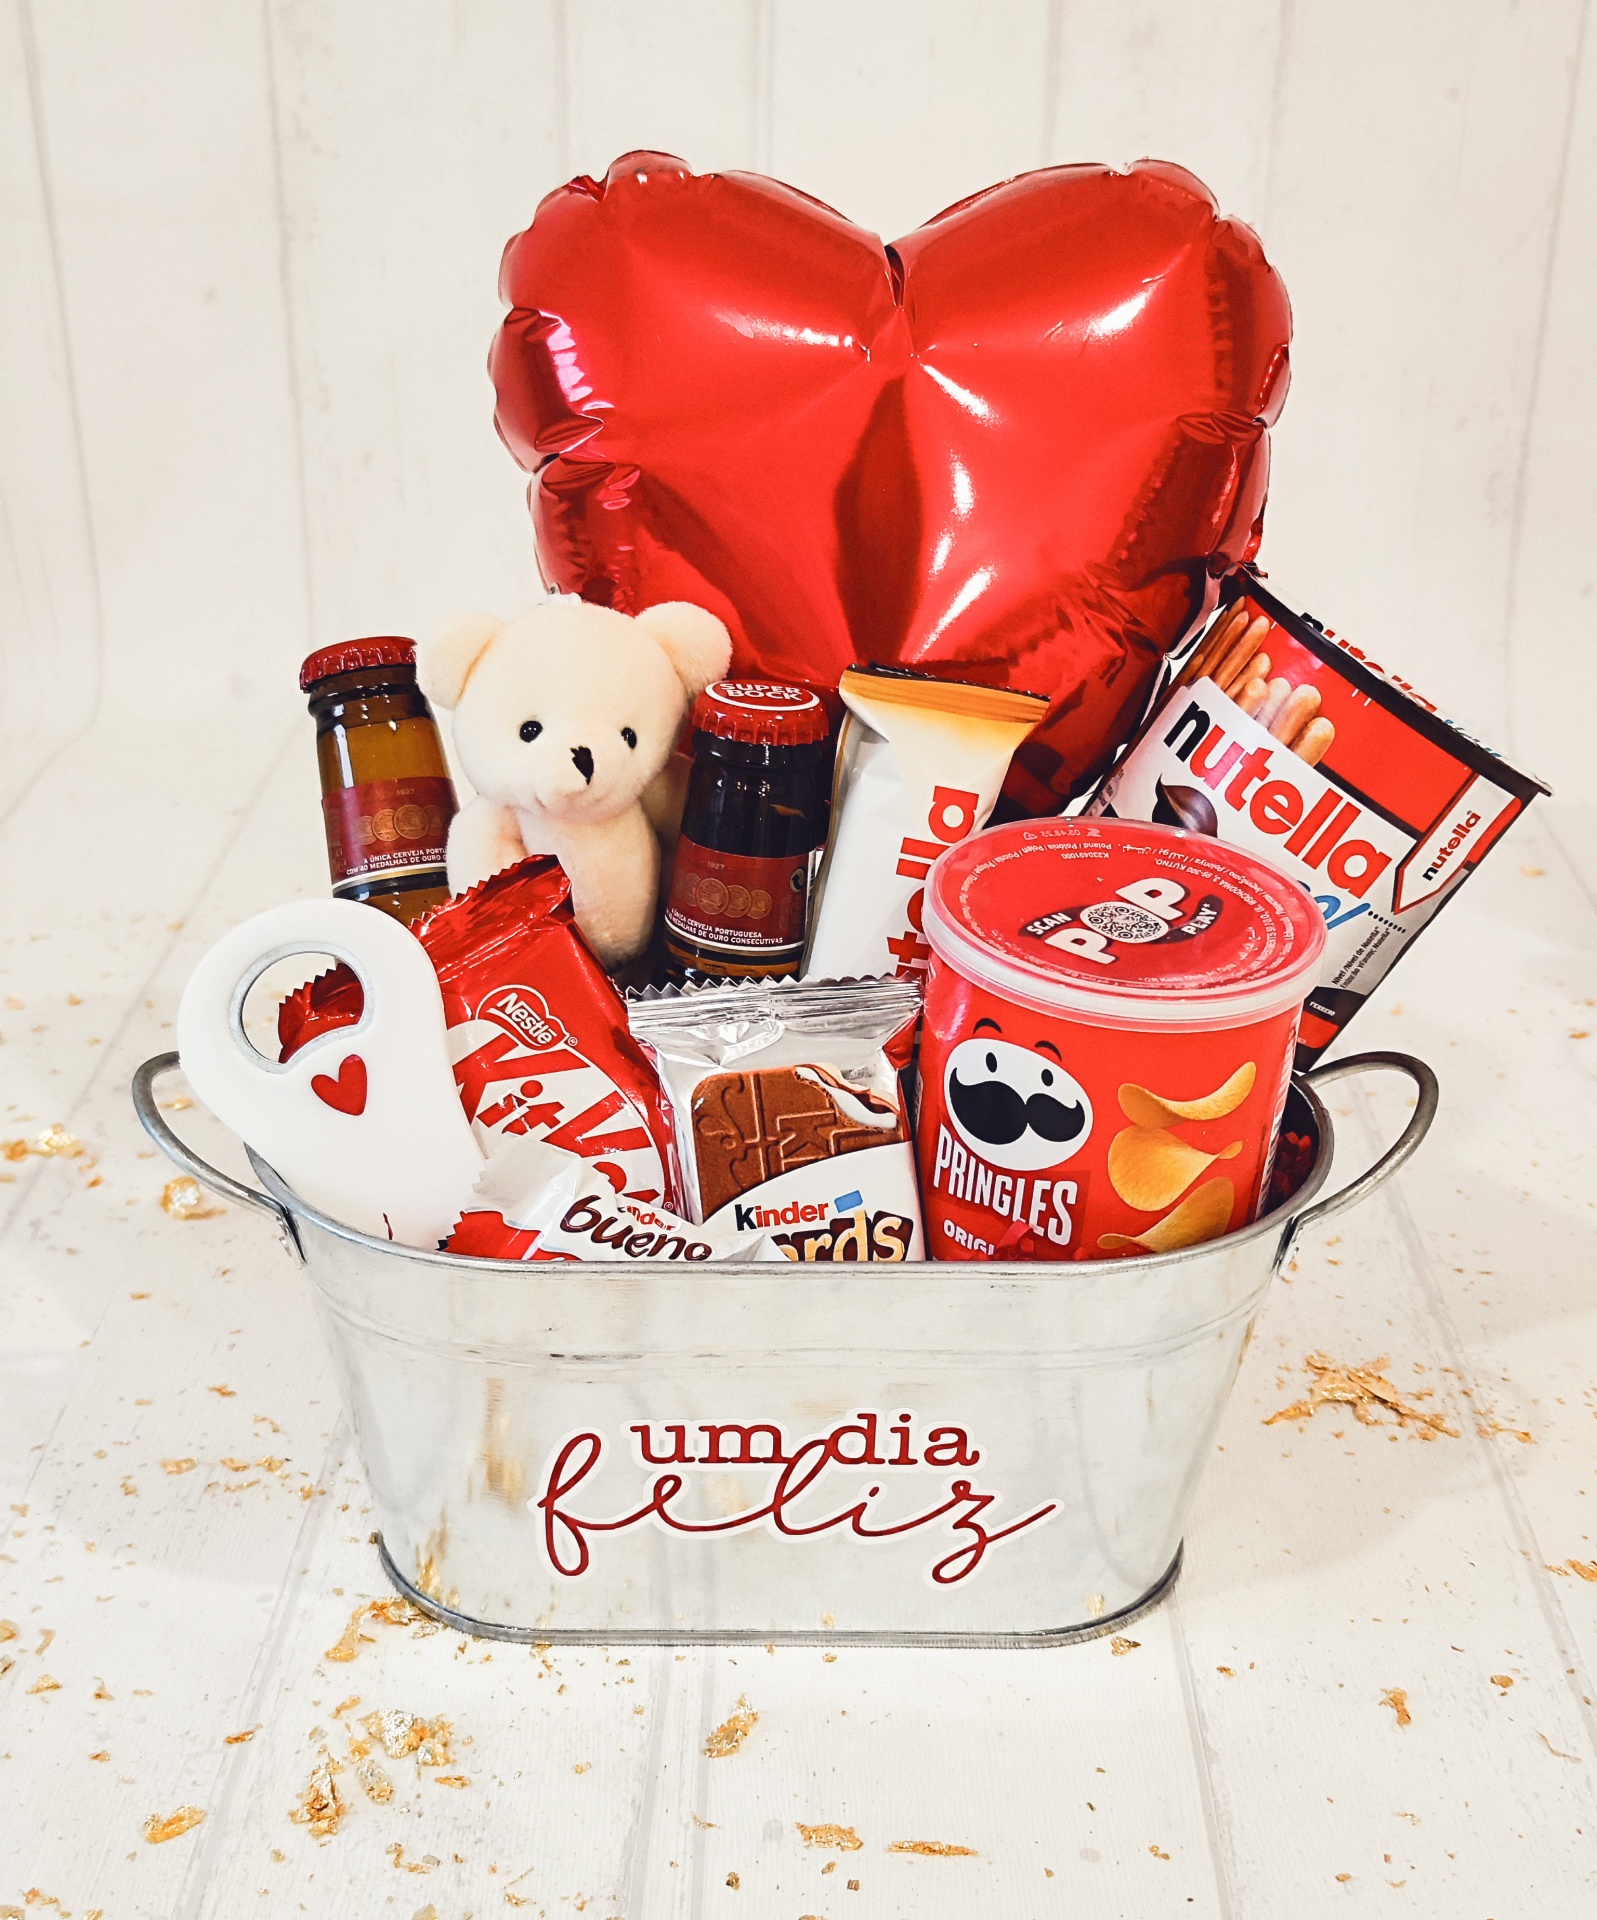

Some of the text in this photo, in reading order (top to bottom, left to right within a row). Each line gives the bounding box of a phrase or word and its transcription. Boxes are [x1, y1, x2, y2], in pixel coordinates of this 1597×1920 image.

[720, 683, 802, 695] SUPER
[727, 689, 802, 701] BOCK
[1163, 701, 1393, 899] nutella
[370, 852, 392, 863] ÚNICA
[393, 848, 424, 859] CERVEJA
[1017, 843, 1045, 853] Polen
[1421, 812, 1481, 882] nutella
[346, 866, 359, 875] COM
[370, 859, 408, 870] MEDALHAS
[422, 854, 441, 862] OURO
[1154, 857, 1187, 870] KUTNO.
[673, 917, 697, 934] MEDALHAS
[698, 930, 707, 938] DE
[708, 932, 729, 943] OURO
[730, 937, 783, 945] CONSECUTIVAS
[687, 919, 713, 932] CERVEJA
[714, 927, 762, 938] PORTUGUESA
[1026, 912, 1072, 935] SCAN
[933, 1122, 1078, 1246] PRINGLES
[559, 1195, 713, 1261] bueno
[735, 1201, 829, 1231] kinder
[630, 1413, 980, 1467] um dia
[537, 1432, 1057, 1584] feliz
